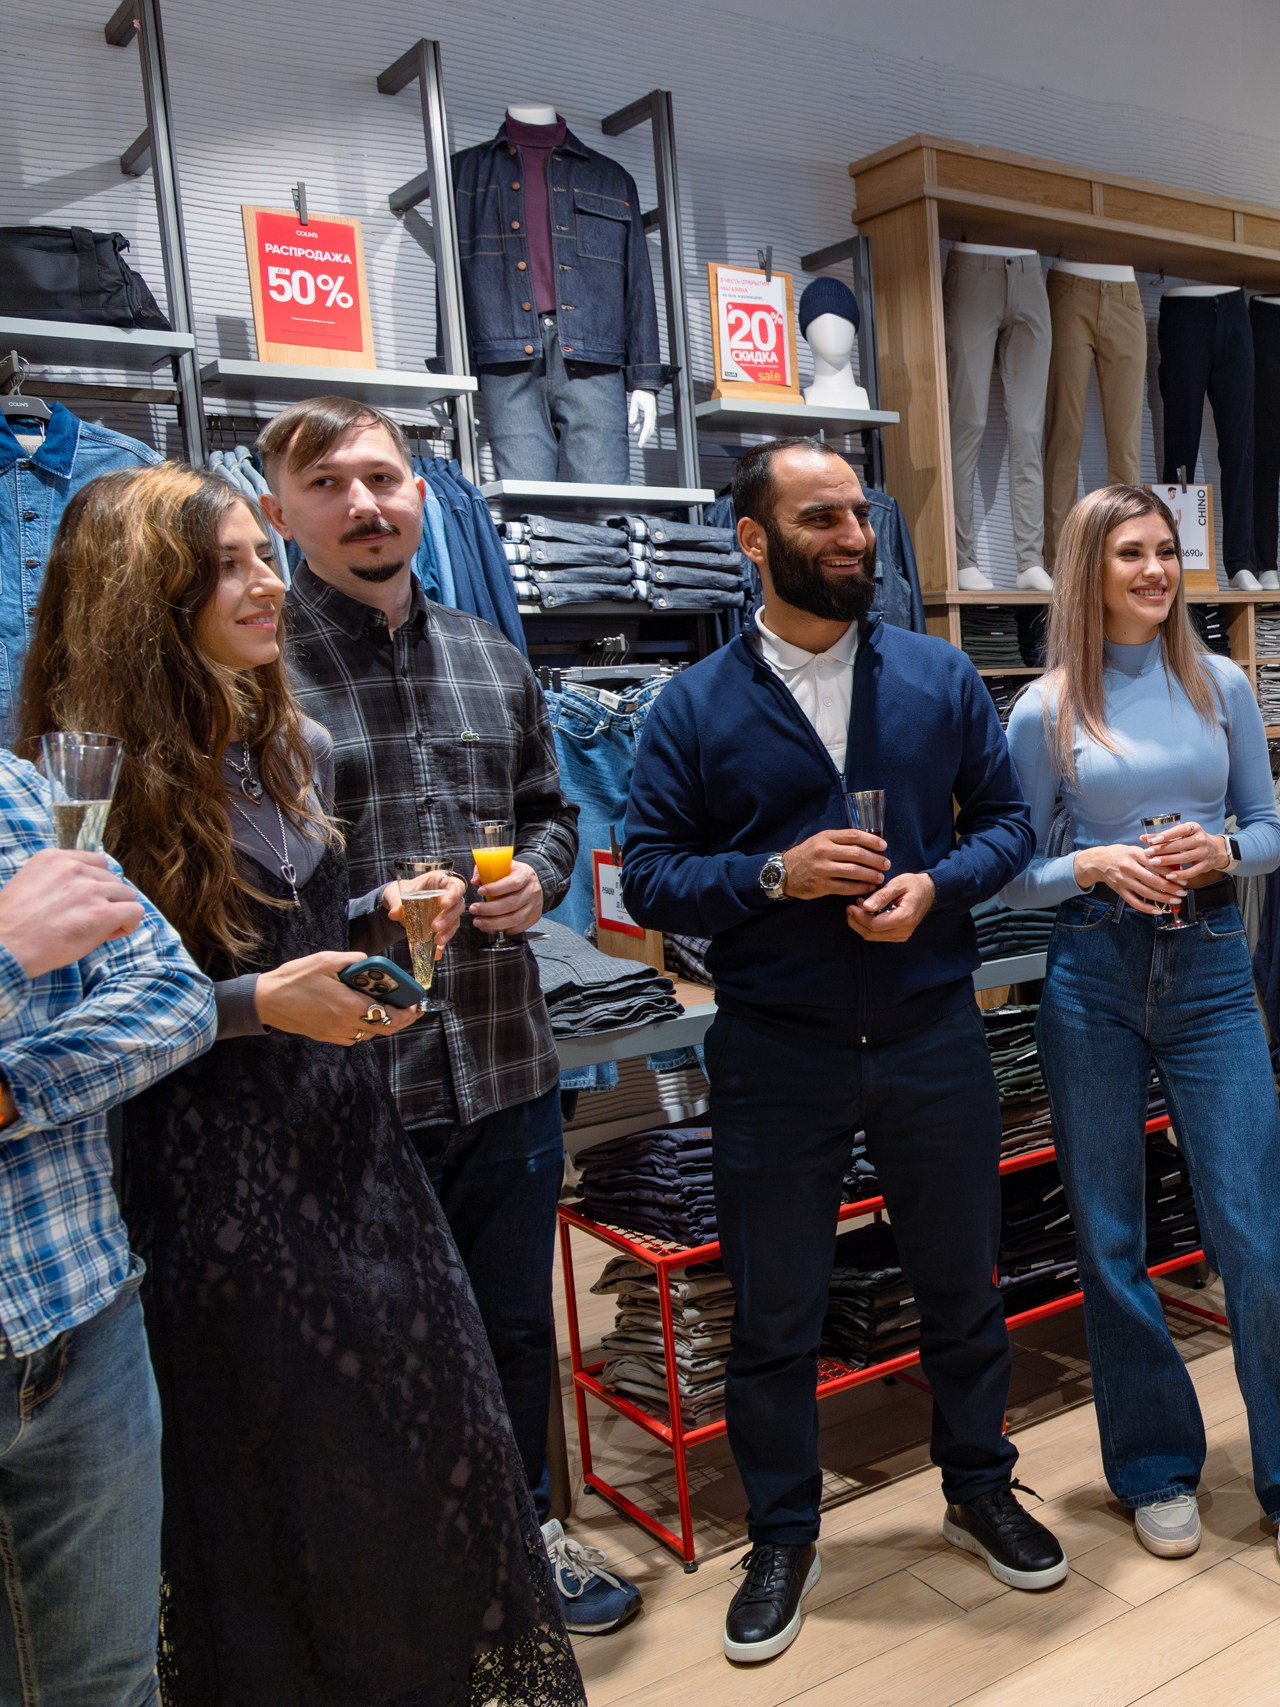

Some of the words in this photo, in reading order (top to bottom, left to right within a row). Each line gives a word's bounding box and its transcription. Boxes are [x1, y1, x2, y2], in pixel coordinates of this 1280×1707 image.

[264, 243, 352, 264] РАСПРОДАЖА
[267, 266, 354, 309] 50%
[731, 350, 779, 365] СКИДКА
[758, 370, 782, 381] sale
[1197, 489, 1207, 526] CHINO
